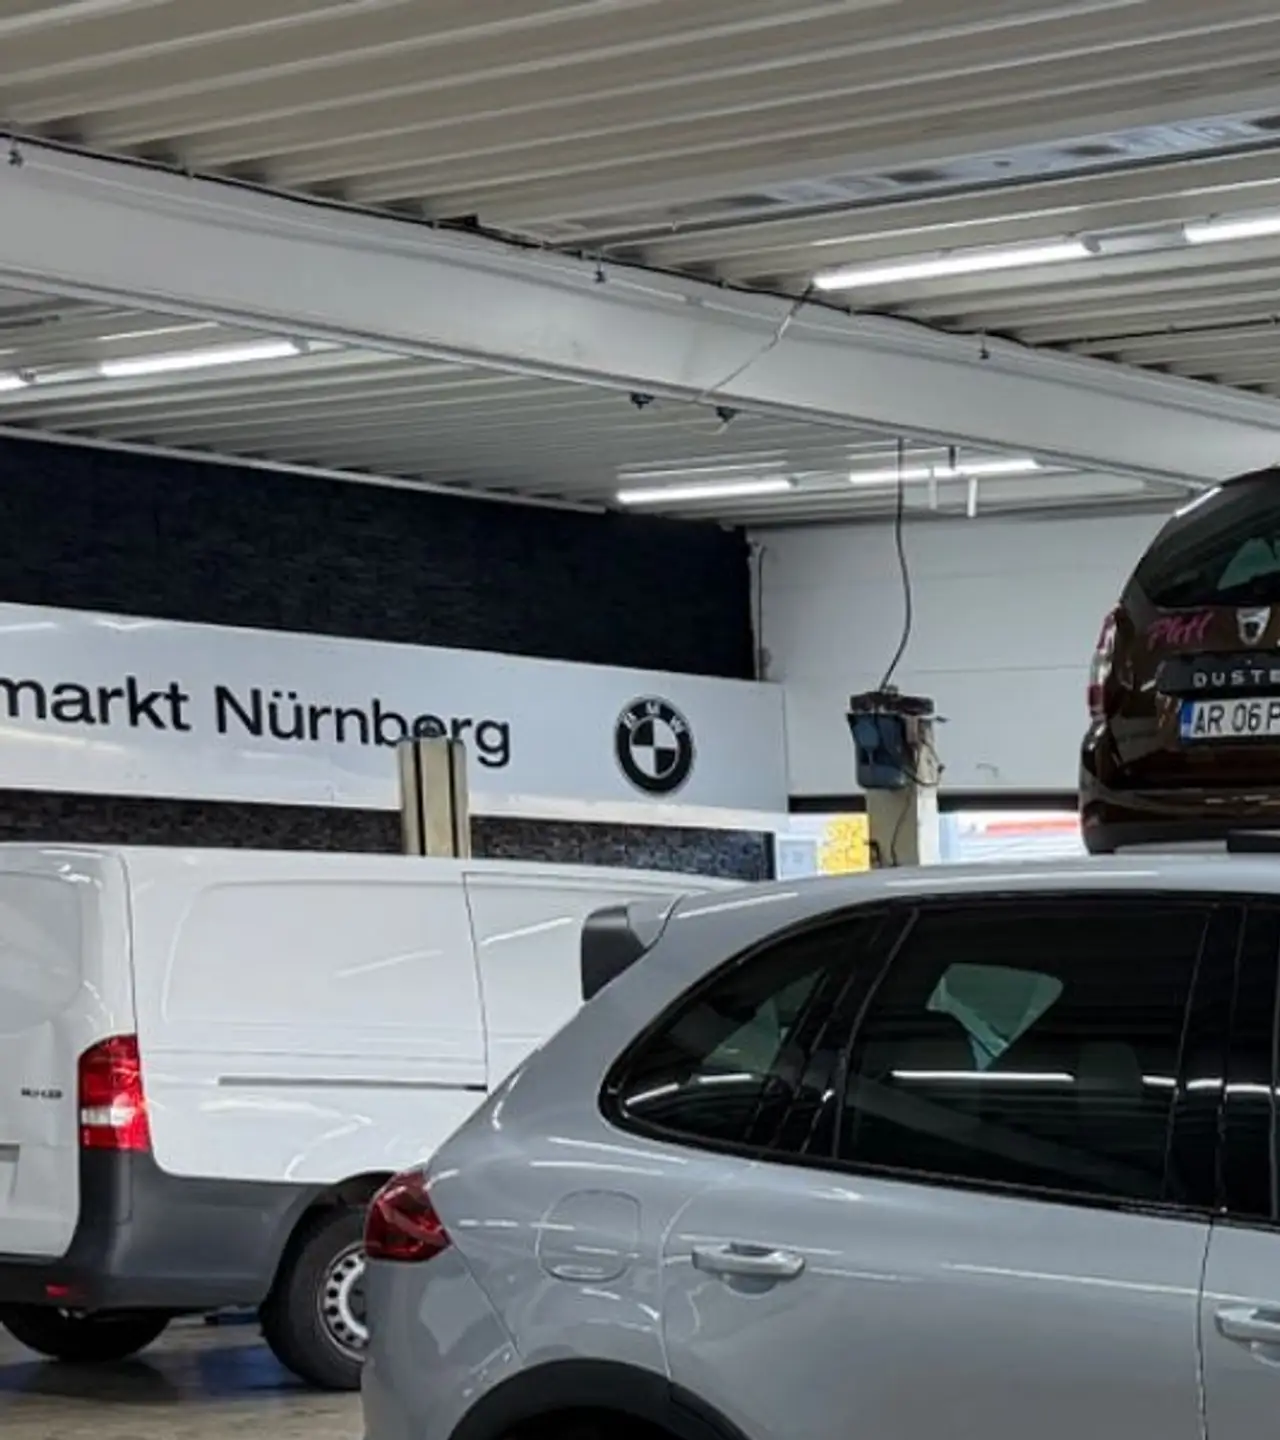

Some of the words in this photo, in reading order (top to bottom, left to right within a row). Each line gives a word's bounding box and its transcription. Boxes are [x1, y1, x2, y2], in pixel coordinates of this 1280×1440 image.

[214, 685, 510, 768] Nürnberg
[622, 699, 688, 733] BMW
[1193, 704, 1225, 734] AR
[1231, 702, 1261, 732] 06
